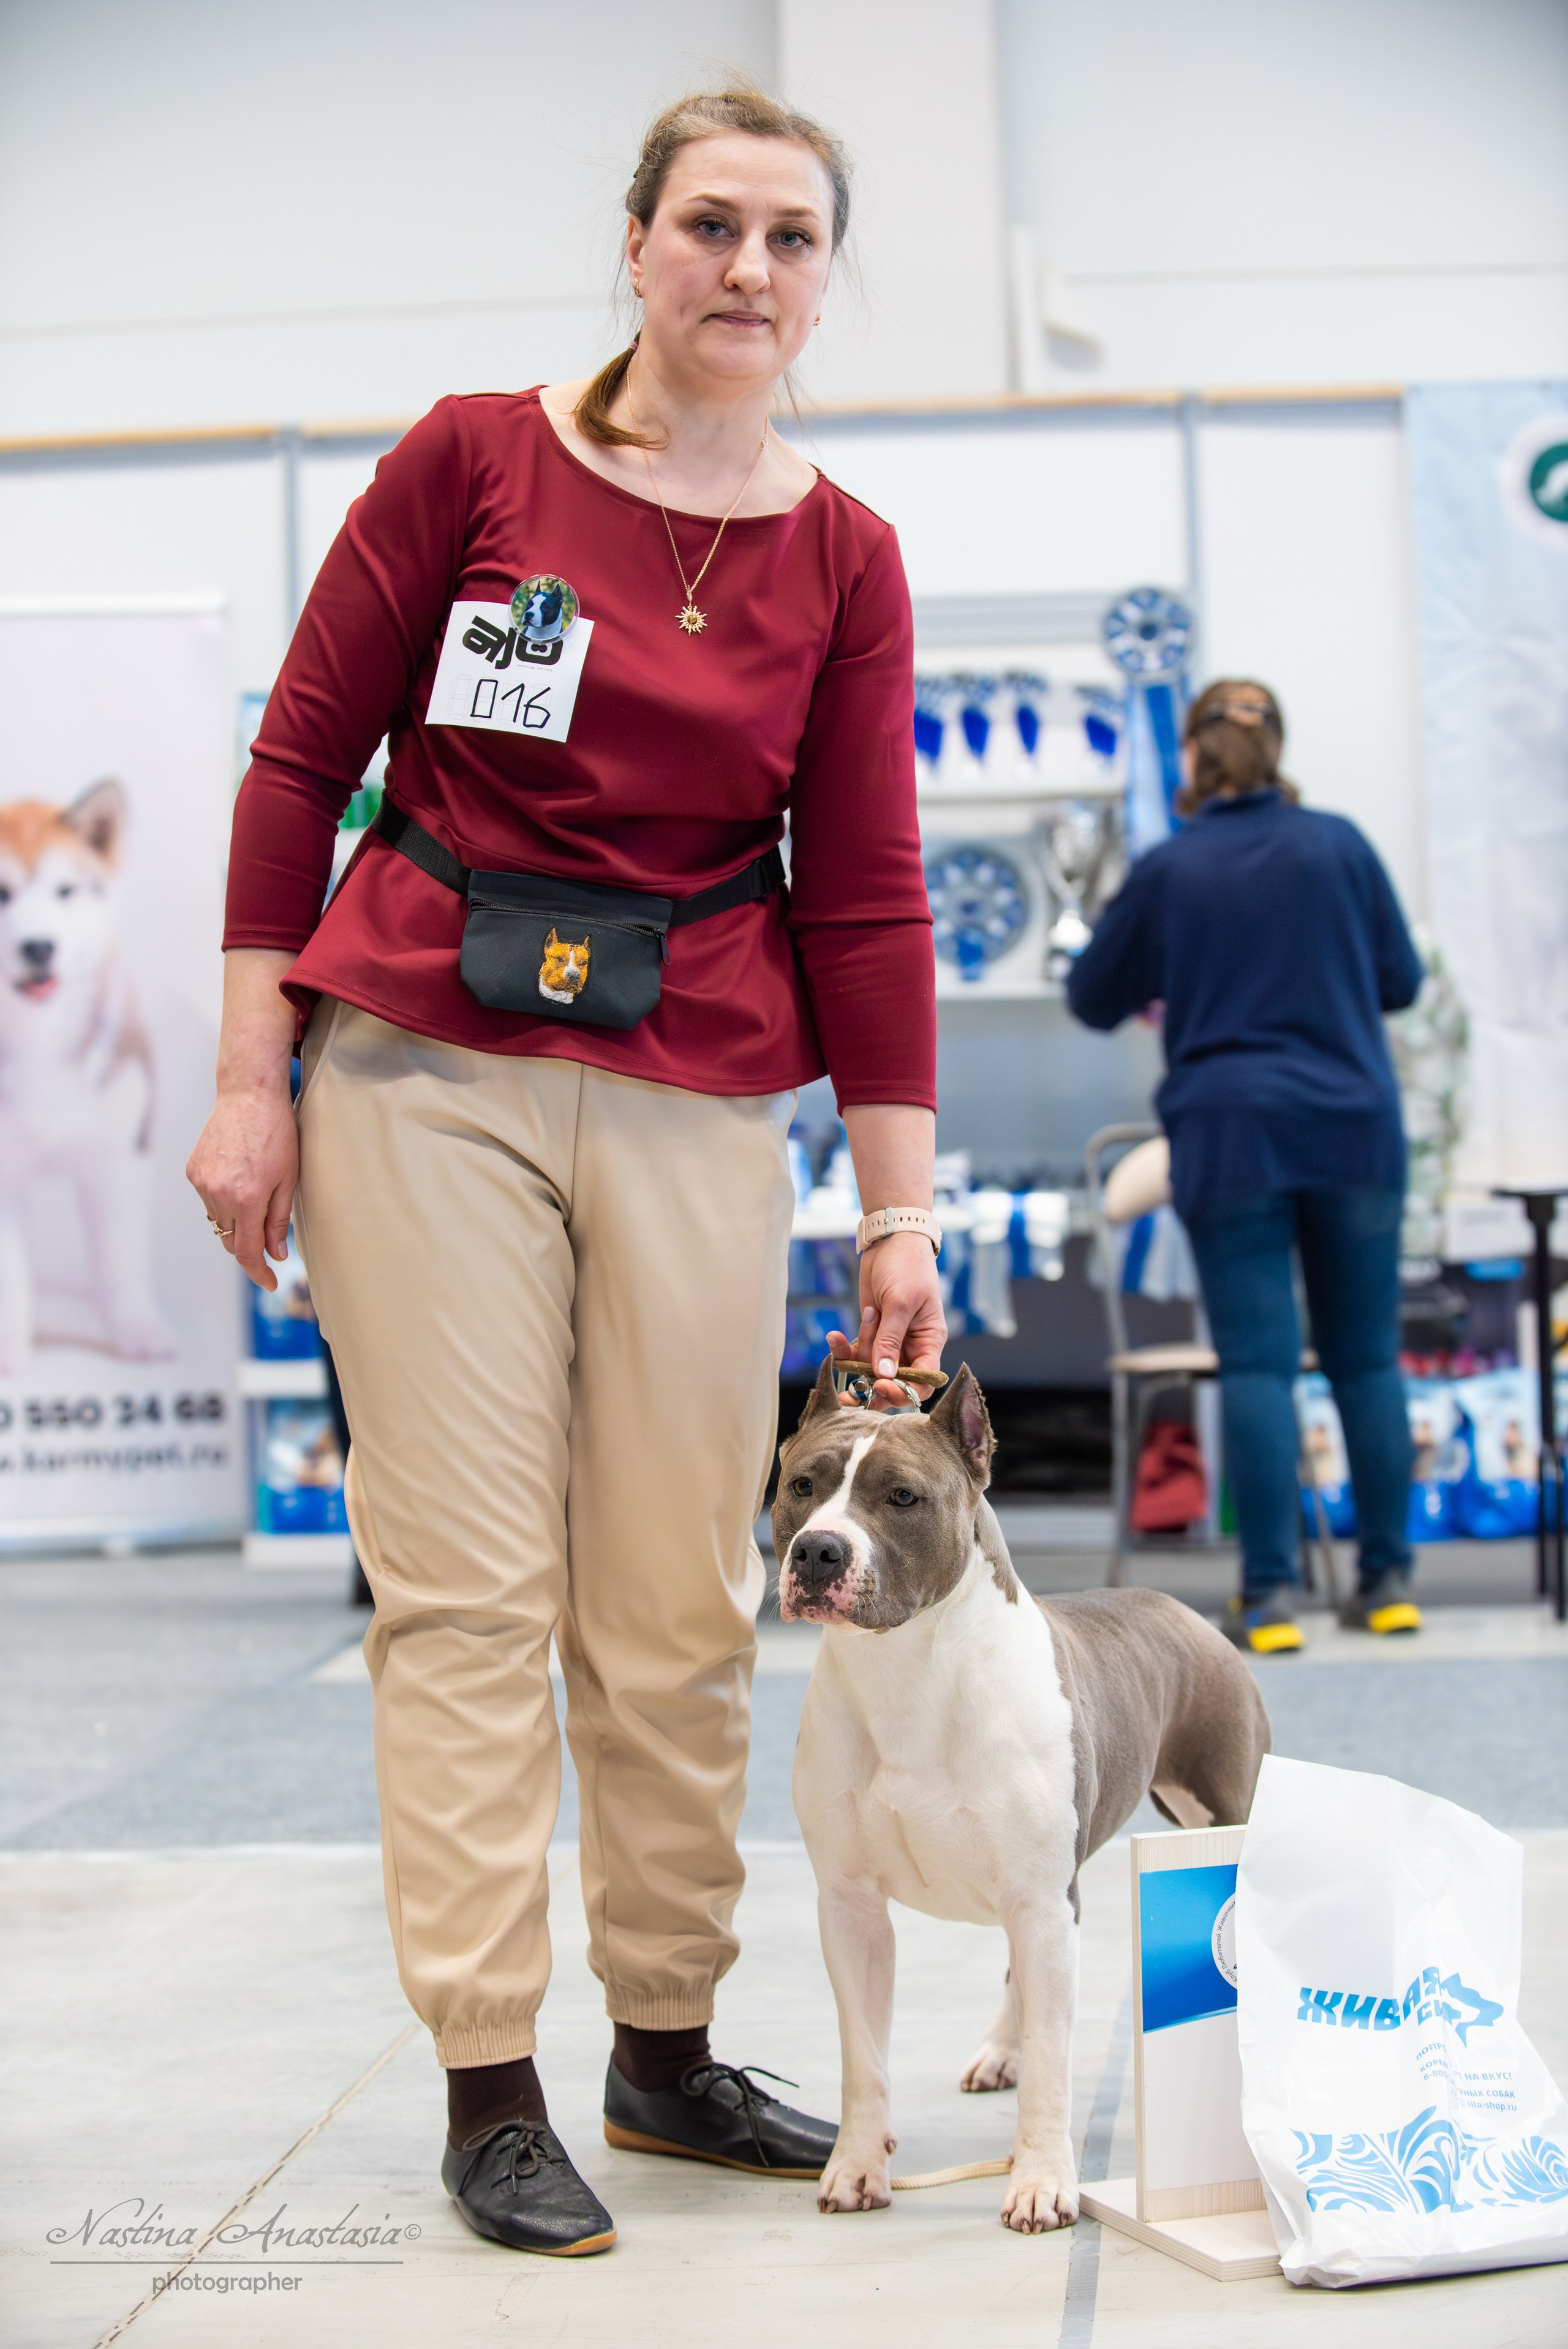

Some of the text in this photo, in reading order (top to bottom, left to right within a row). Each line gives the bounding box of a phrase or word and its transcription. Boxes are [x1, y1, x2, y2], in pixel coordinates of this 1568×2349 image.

[470, 679, 551, 728] 016
[1297, 1966, 1442, 2031] ЖИВАЯ
[1482, 2072, 1512, 2081] ВКУС!
[1487, 2089, 1515, 2098] СОБАК
